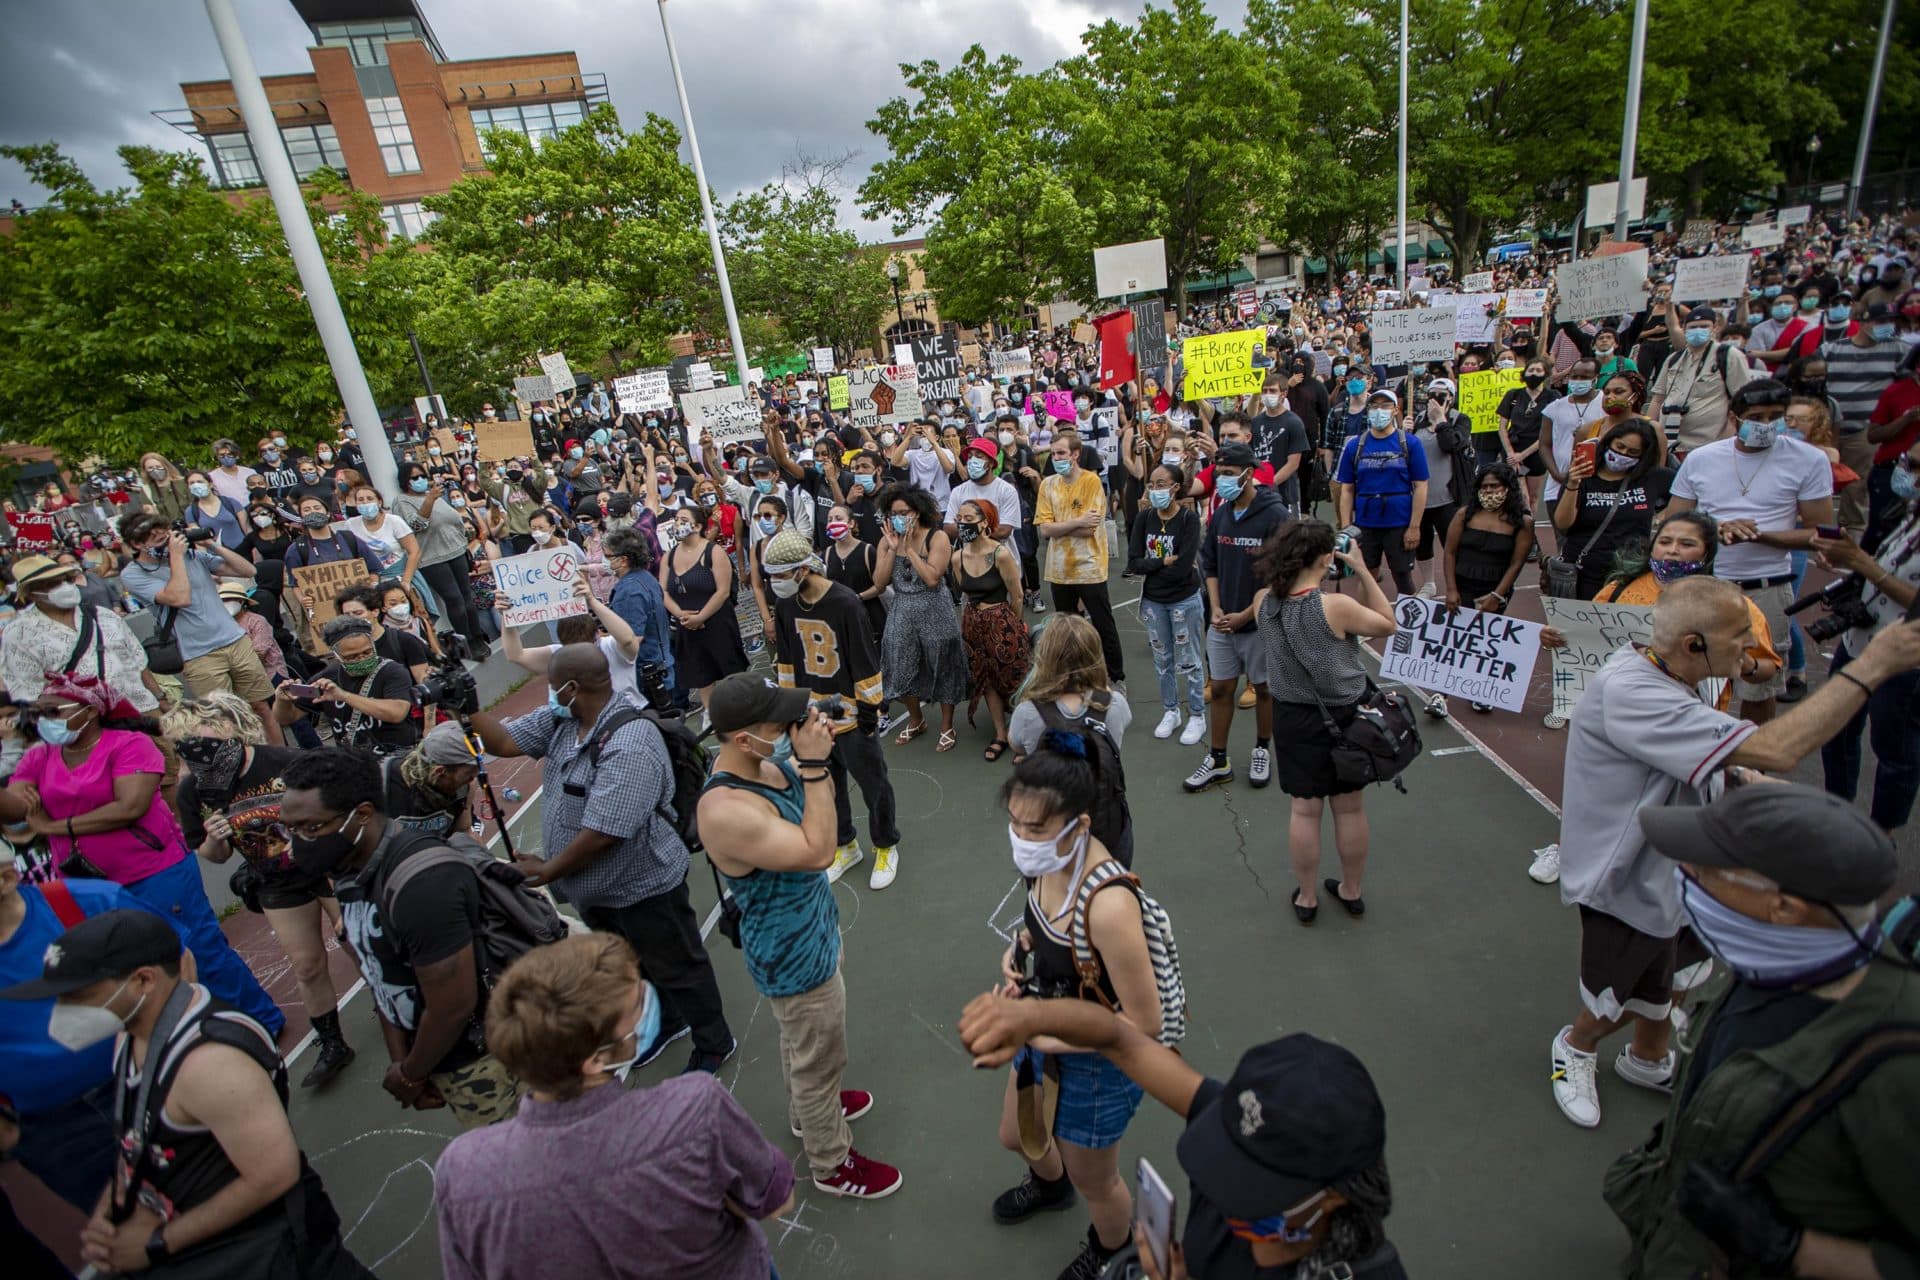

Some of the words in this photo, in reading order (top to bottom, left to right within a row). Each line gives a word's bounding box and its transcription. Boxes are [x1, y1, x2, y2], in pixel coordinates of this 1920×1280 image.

[1569, 287, 1592, 299] NOT
[1374, 314, 1408, 328] WHITE
[918, 335, 947, 357] WE
[1389, 332, 1441, 344] NOURISHES
[1190, 341, 1247, 360] #BLACK
[1375, 352, 1400, 362] WHITE
[917, 357, 956, 379] CAN'T
[1204, 356, 1245, 374] LIVES
[847, 367, 887, 385] BLACK
[1193, 371, 1262, 397] MATTER!
[1462, 372, 1520, 389] RIOTING
[851, 398, 874, 411] LIVES
[1462, 392, 1473, 404] IS
[702, 405, 731, 418] BLACK
[853, 415, 882, 425] MATTER
[264, 468, 298, 487] TRUTH
[1586, 490, 1631, 500] DISSET
[1586, 495, 1647, 507] PATROTIC
[1147, 534, 1175, 547] BLACK
[300, 561, 365, 585] WHITE
[496, 563, 545, 591] Police
[559, 587, 569, 600] is
[505, 608, 548, 625] Modern
[1431, 603, 1524, 645] BLACK
[794, 617, 840, 678] B
[1418, 622, 1500, 658] LIVES
[1421, 642, 1517, 682] MATTER
[1553, 646, 1614, 667] Blac
[1384, 652, 1398, 674] I
[1400, 655, 1440, 684] can't
[1444, 666, 1511, 704] breathe
